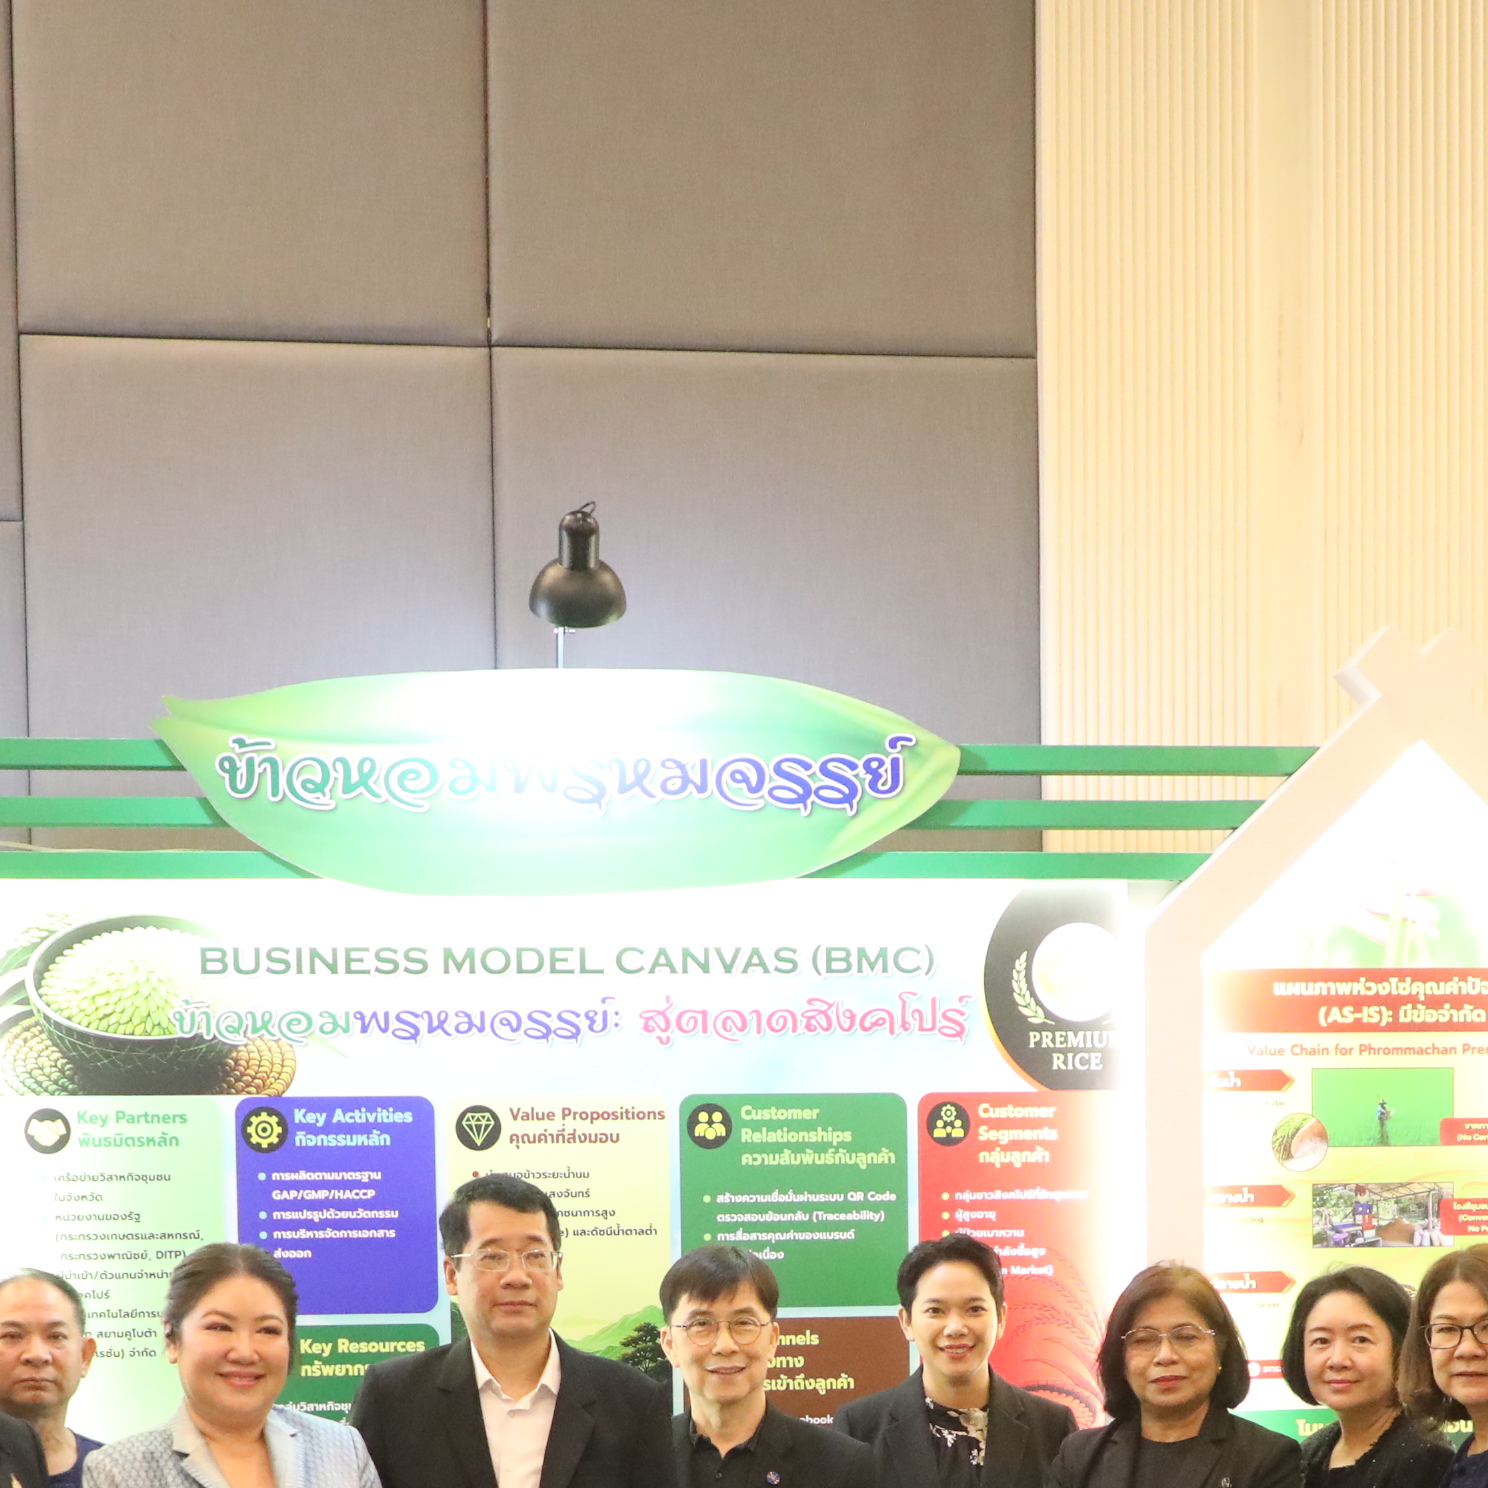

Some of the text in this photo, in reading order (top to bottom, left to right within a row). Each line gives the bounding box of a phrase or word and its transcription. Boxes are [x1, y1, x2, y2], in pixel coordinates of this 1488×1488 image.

[218, 736, 916, 816] ข้าวหอมพรหมจรรย์
[198, 943, 935, 978] BUSINESS MODEL CANVAS (BMC)
[638, 992, 974, 1047] สู่ตลาดสิงคโปร์
[1317, 1003, 1487, 1027] (AS-IS): มีข้อจำกัด
[1247, 1044, 1285, 1057] Value
[1290, 1043, 1330, 1057] Chain
[1334, 1043, 1354, 1056] for
[1358, 1042, 1458, 1058] Phrommachan
[1051, 1052, 1104, 1071] RICE
[76, 1109, 188, 1128] Key Partners
[293, 1107, 414, 1127] Key Activities
[508, 1106, 666, 1125] Value Propositions
[740, 1104, 820, 1120] Customer
[978, 1103, 1057, 1118] Customer
[78, 1131, 180, 1148] พันธมิตรหลัก
[294, 1129, 391, 1147] กิจกรรมหลัก
[508, 1124, 620, 1150] คุณค่าที่ส่งมอบ
[740, 1126, 852, 1146] Relationships
[978, 1126, 1059, 1144] Segments
[741, 1148, 896, 1170] ความสัมพันธ์กับลูกค้า
[978, 1146, 1051, 1168] กลุ่มลูกค้า
[53, 1172, 172, 1185] เครือข่ายวิสาหกิจชุมชน
[271, 1169, 382, 1183] การผลิตตามมาตรฐาน
[54, 1191, 104, 1202] ในจังหวัด
[271, 1188, 376, 1201] GAP/GMP/HACCP
[716, 1189, 897, 1204] สร้างความเชื่อมั่นผ่านระบบ QR Code
[55, 1211, 142, 1224] หน่วยงานของรัฐ
[272, 1207, 399, 1222] การแปรรูปด้วยนวัตกรรม
[716, 1209, 886, 1223] ตรวจสอบย้อนกลับ (Traceability)
[954, 1208, 997, 1222] ผู้สูงอายุ
[273, 1227, 396, 1240] การบริหารจัดการเอกสาร
[572, 1222, 658, 1237] และดัชนีน้ำตาลต่ำ
[717, 1228, 856, 1244] การสื่อสารคุณค่าของแบรนด์
[155, 1249, 187, 1261] DITP)
[274, 1247, 312, 1259] ส่งออก
[1011, 1264, 1054, 1277] Market)
[96, 1329, 158, 1342] สยามคูโบต้า
[778, 1329, 820, 1346] nnels
[128, 1347, 157, 1358] จำกัด
[299, 1337, 426, 1358] Key Resources
[762, 1372, 856, 1396] รเข้าถึงลูกค้า
